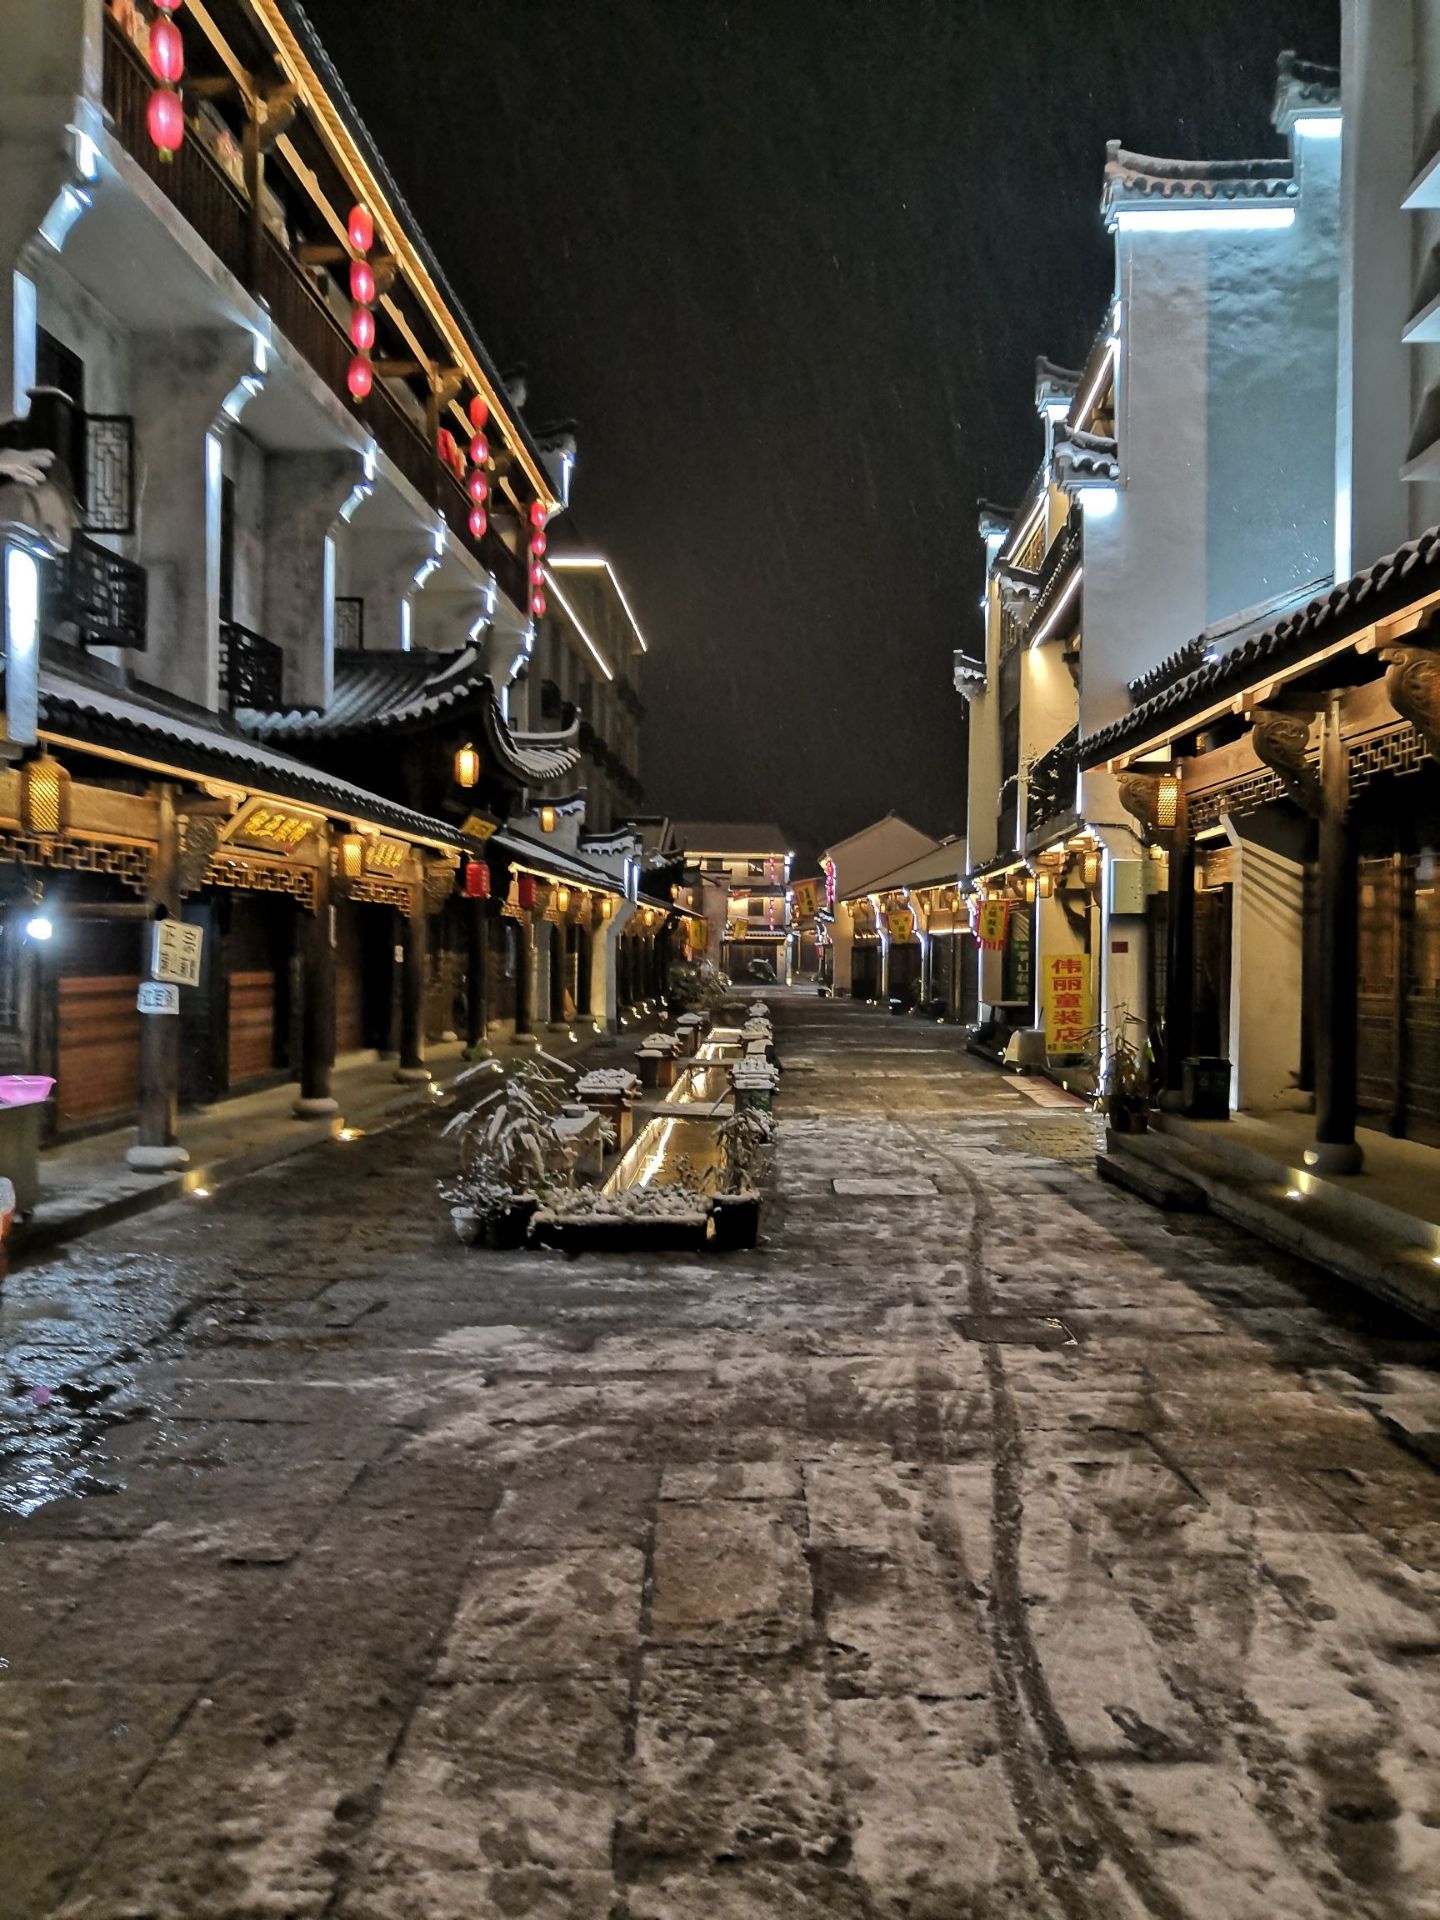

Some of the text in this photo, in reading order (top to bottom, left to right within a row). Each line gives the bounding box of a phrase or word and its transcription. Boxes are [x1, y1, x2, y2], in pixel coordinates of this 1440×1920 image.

[1051, 959, 1083, 1042] 伟丽童装店
